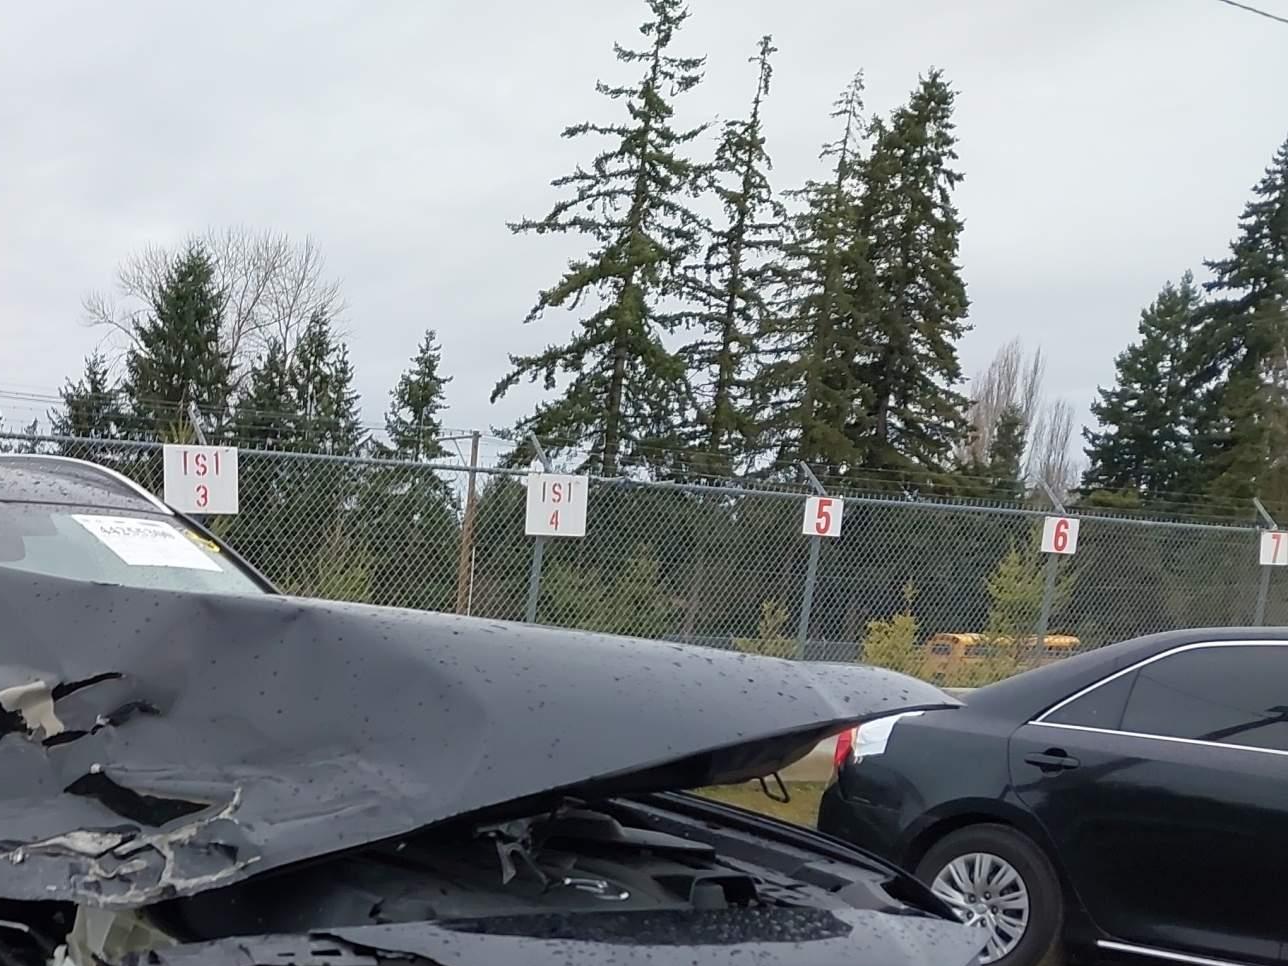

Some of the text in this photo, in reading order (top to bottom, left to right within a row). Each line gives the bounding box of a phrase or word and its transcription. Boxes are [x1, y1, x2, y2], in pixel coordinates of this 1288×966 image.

[196, 485, 208, 508] 3
[549, 510, 560, 531] 4
[815, 499, 833, 534] 5
[1053, 518, 1070, 552] 6
[1271, 533, 1282, 564] 7
